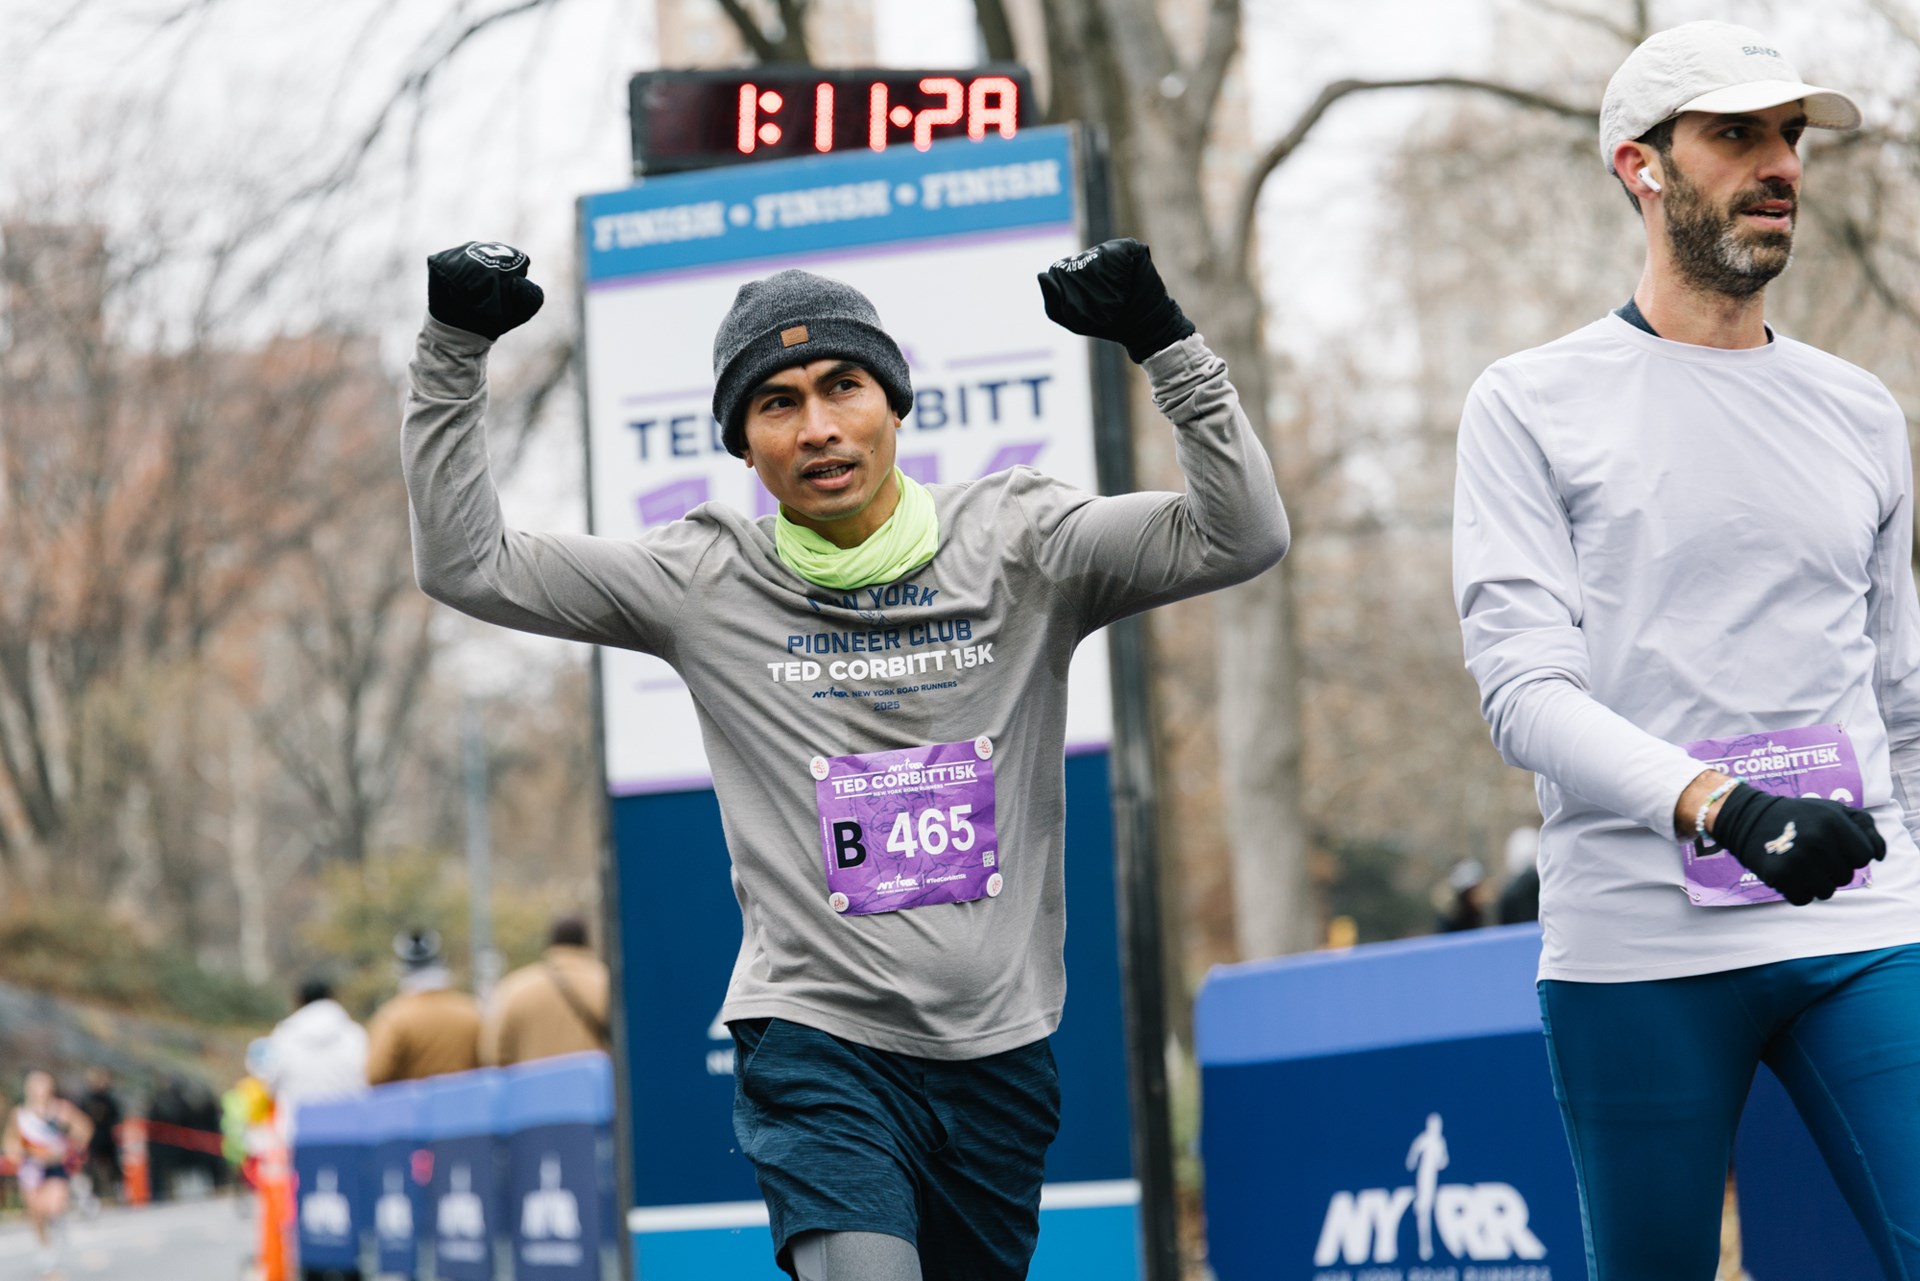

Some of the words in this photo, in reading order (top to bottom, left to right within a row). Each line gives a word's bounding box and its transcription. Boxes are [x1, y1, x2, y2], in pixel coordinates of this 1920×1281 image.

[593, 200, 726, 251] FINISH
[754, 180, 893, 230] FINISH
[921, 159, 1061, 209] FINISH
[867, 583, 939, 609] YORK
[787, 628, 901, 654] PIONEER
[909, 618, 972, 647] CLUB
[767, 662, 821, 683] TED
[829, 651, 947, 681] CORBITT
[950, 643, 994, 670] 15K
[873, 688, 895, 697] YORK
[897, 685, 919, 694] ROAD
[921, 680, 958, 691] RUNNERS
[873, 700, 900, 712] 2025
[1733, 751, 1809, 775] CORBITT
[1809, 747, 1840, 765] 15K
[832, 777, 867, 795] TED
[871, 767, 947, 789] CORBITT
[948, 764, 977, 781] 15K
[833, 821, 867, 869] B
[886, 803, 975, 858] 465
[1313, 1181, 1548, 1268] NYRR
